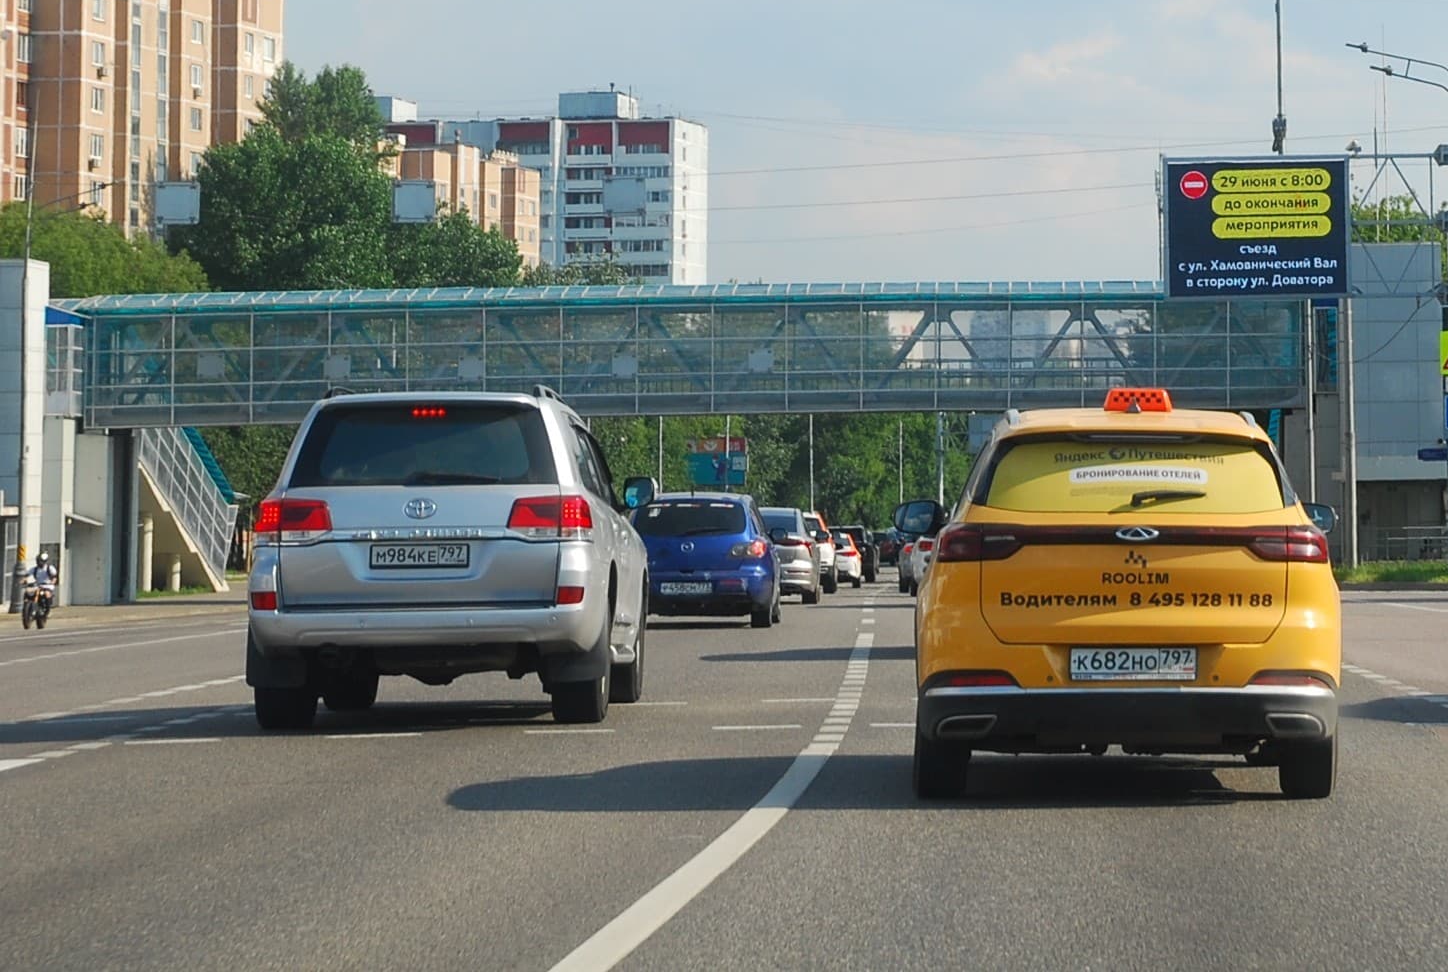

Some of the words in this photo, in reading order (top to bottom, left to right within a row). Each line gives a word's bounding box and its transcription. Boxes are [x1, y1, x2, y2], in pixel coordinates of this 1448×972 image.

[1219, 176, 1237, 188] 29
[1241, 178, 1276, 188] июня
[1280, 178, 1288, 187] с
[1291, 174, 1324, 186] 8:00
[1223, 200, 1241, 211] до
[1245, 198, 1319, 209] окончания
[1225, 219, 1319, 233] мероприятия
[1239, 244, 1278, 256] съезд
[1178, 263, 1186, 272] с
[1188, 261, 1207, 274] ул.
[1210, 257, 1311, 271] Хамовнический
[1314, 257, 1338, 269] Вал
[1186, 279, 1194, 288] в
[1197, 276, 1248, 291] сторону
[1250, 276, 1269, 289] ул.
[1271, 274, 1334, 289] Доватора
[1054, 449, 1105, 463] Яндекс
[1076, 469, 1158, 479] БРОНИРОВАНИЕ
[1161, 469, 1201, 480] ОТЕЛЕЙ
[375, 547, 437, 563] М984КЕ
[440, 546, 463, 558] 797
[1102, 572, 1169, 585] ROOLIM
[1000, 592, 1117, 608] Водителям
[1129, 592, 1142, 607] 8
[1148, 592, 1185, 607] 495
[1191, 592, 1222, 607] 128
[1228, 592, 1243, 607] 11
[1249, 592, 1273, 607] 88
[1077, 651, 1158, 671] К682НО
[1161, 649, 1192, 666] 797
